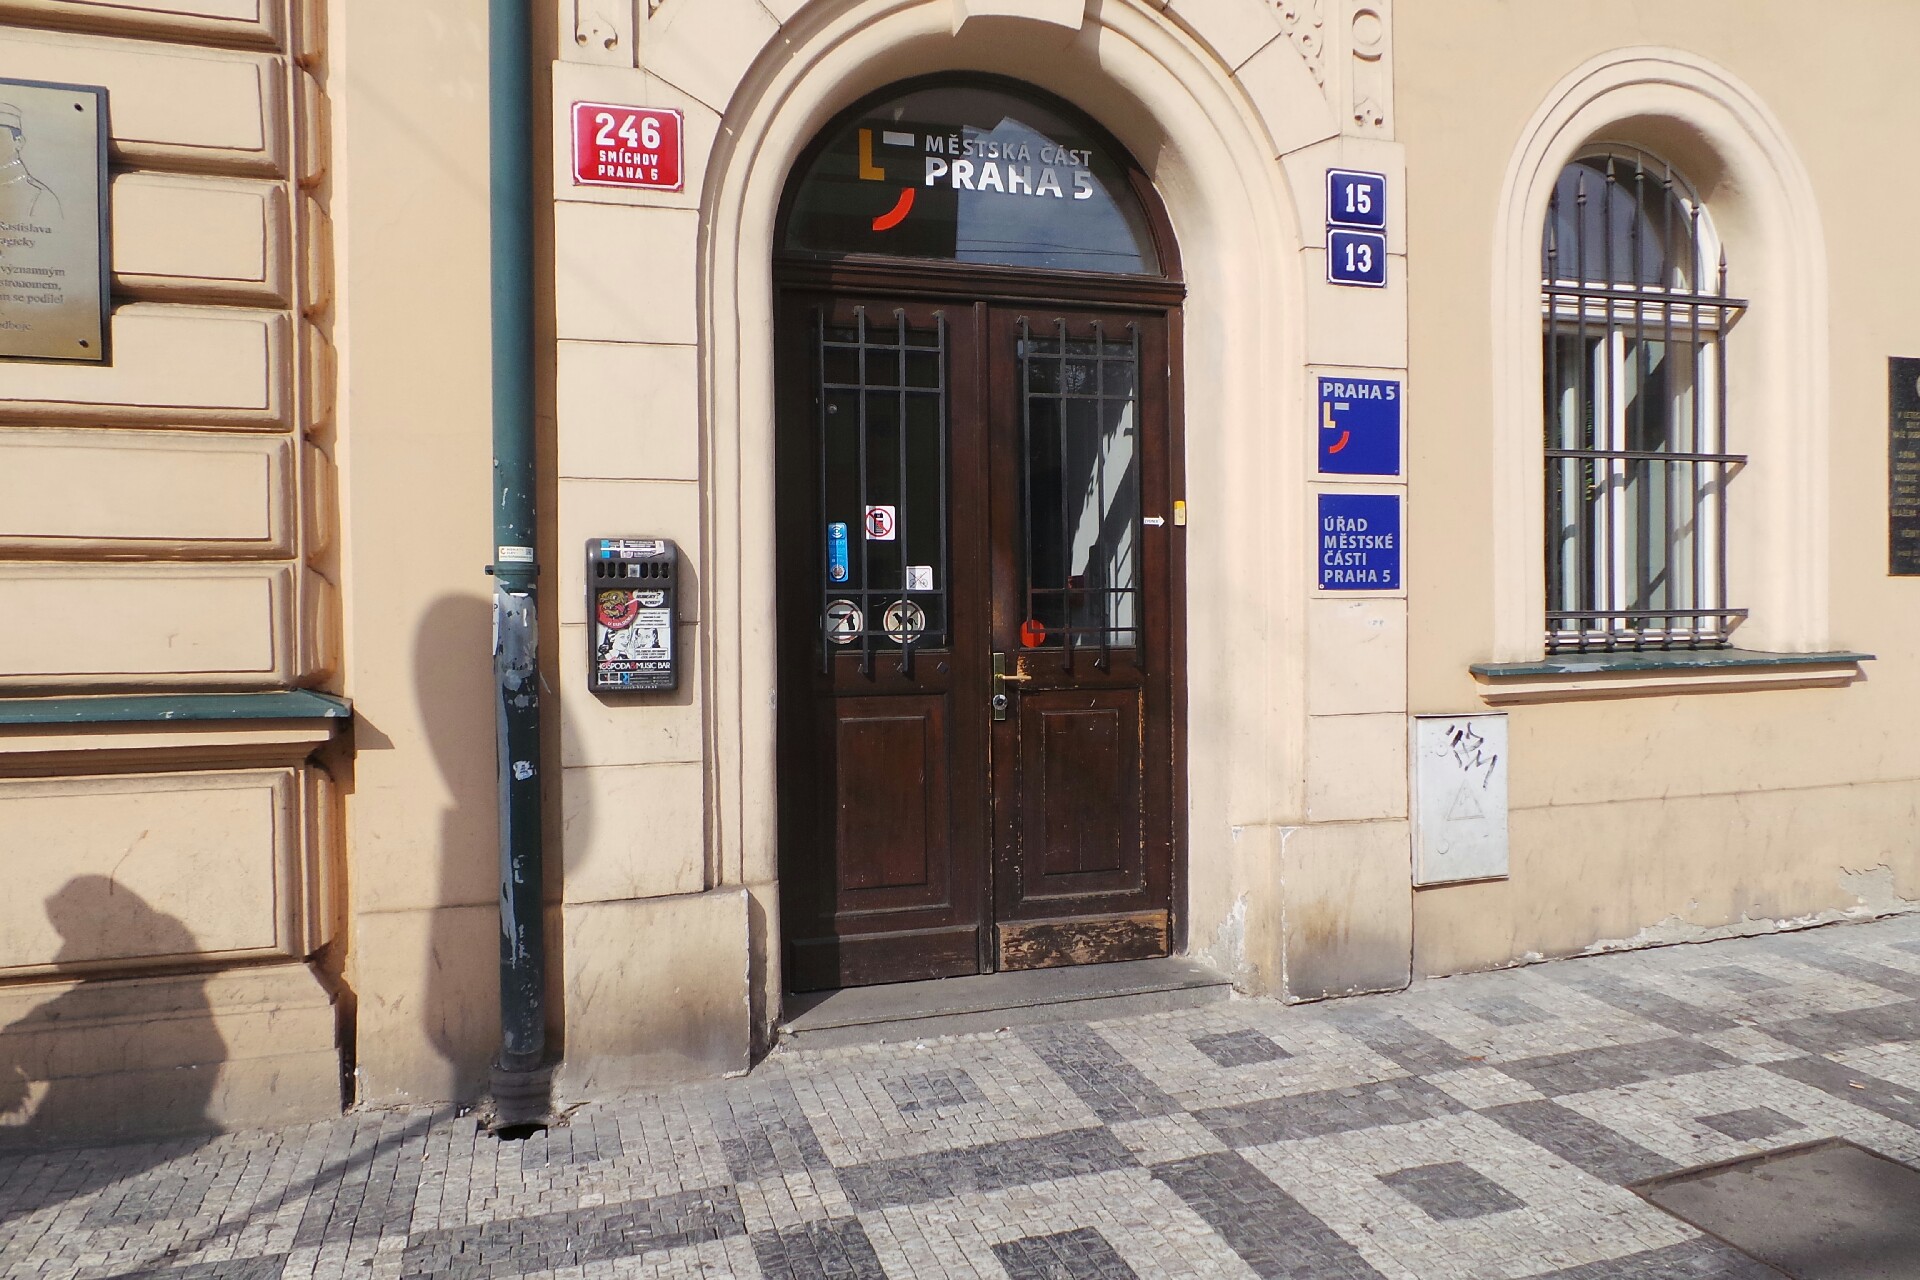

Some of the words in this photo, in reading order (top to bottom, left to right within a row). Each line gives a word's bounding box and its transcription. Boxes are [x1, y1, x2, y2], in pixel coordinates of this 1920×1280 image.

[595, 112, 661, 149] 246
[599, 148, 659, 166] SMÍCHOV
[925, 134, 1031, 161] MĚSTSKÁ
[1040, 144, 1093, 167] ČÁST
[597, 164, 644, 180] PRAHA
[650, 168, 659, 181] 5
[925, 156, 1064, 199] PRAHA
[1073, 170, 1094, 200] 5
[1345, 183, 1371, 214] 15
[1345, 243, 1372, 273] 13
[1323, 382, 1382, 400] PRAHA
[1386, 385, 1396, 401] 5
[1324, 515, 1368, 532] ÚŘAD
[1324, 533, 1394, 549] MĚSTSKÉ
[1323, 549, 1367, 566] ČÁSTI
[1324, 569, 1378, 583] PRAHA
[1382, 569, 1391, 583] 5
[637, 662, 657, 670] MUSIC
[658, 662, 671, 670] BAR
